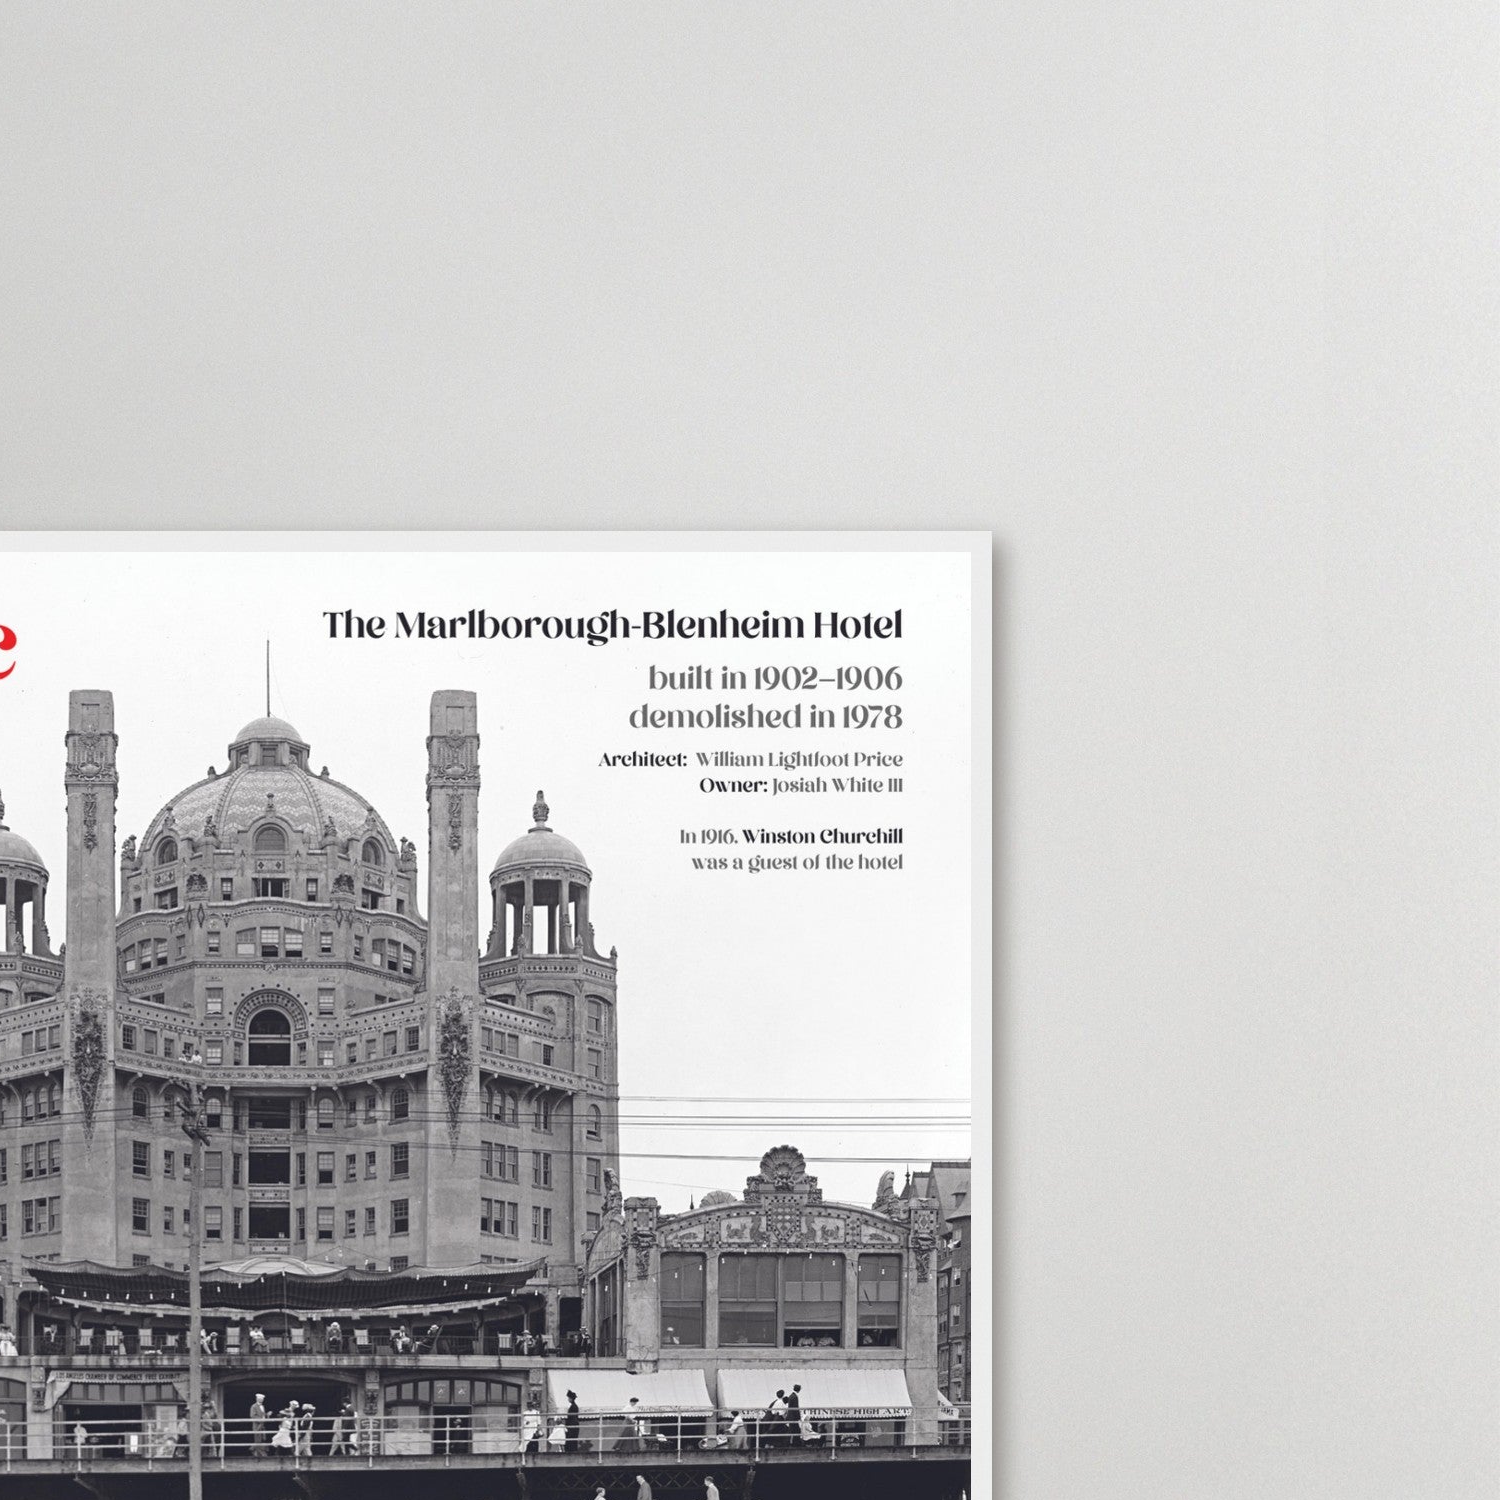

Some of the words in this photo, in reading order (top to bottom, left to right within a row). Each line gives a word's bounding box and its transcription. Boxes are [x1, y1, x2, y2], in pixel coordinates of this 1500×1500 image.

[323, 609, 385, 639] The
[395, 609, 804, 647] Marlborough-Blenheim
[815, 609, 902, 639] Hotel
[650, 665, 712, 690] built
[722, 665, 746, 690] in
[630, 704, 801, 729] demolished
[811, 704, 834, 728] in
[844, 704, 903, 729] 1978
[599, 750, 687, 767] Architect:
[696, 750, 763, 767] William
[769, 750, 849, 771] Lightfoot
[855, 751, 903, 767] Price
[700, 777, 767, 794] Owner:
[773, 776, 827, 796] Josiah
[832, 776, 883, 793] White
[888, 778, 903, 793] III
[680, 829, 697, 844] In
[742, 828, 816, 844] Winston
[820, 828, 903, 844] Churchill
[691, 857, 728, 870] was
[733, 857, 743, 870] a
[749, 854, 798, 874] guest
[803, 854, 820, 870] of
[826, 853, 854, 870] the
[858, 853, 903, 870] hotel
